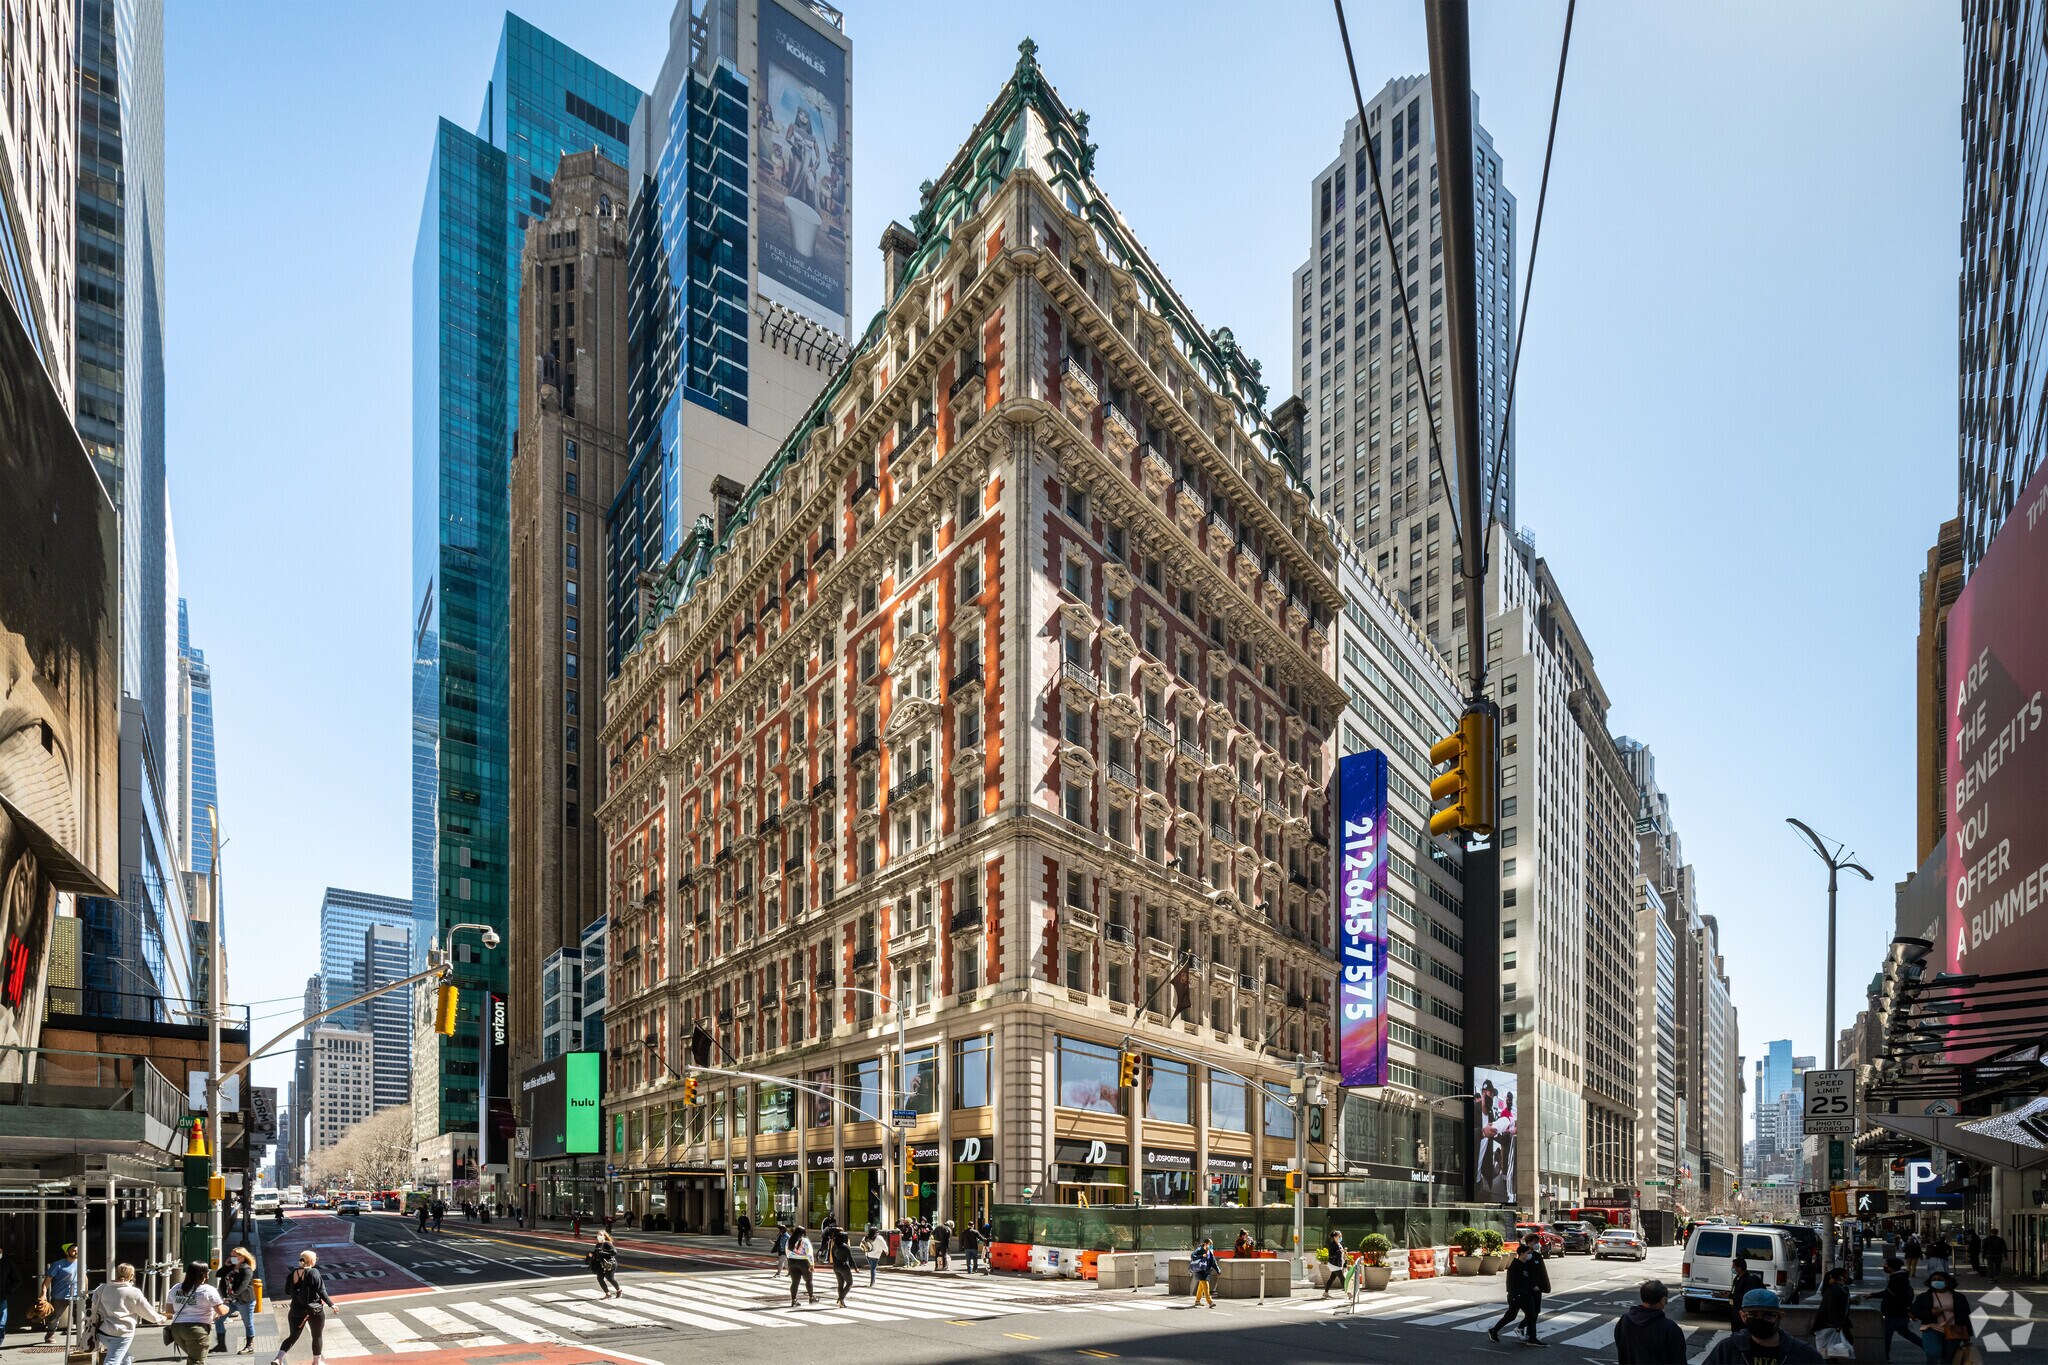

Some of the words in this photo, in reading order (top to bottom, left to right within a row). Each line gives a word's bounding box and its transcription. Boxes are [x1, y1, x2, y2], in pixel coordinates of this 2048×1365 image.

[776, 35, 785, 44] OF
[770, 245, 788, 259] FEEL
[790, 256, 805, 268] LIKE
[814, 269, 838, 287] QUEEN
[771, 252, 782, 264] ON
[785, 260, 801, 274] THIS
[1956, 646, 1989, 718] ARE
[1956, 700, 1986, 762] THE
[1956, 690, 2043, 814] BENEFITS
[1956, 802, 1988, 859] YOU
[1956, 838, 2010, 908] OFFER
[1344, 817, 1373, 1021] 212-645-7575
[1956, 926, 1968, 961] A
[1972, 862, 2048, 950] BUMMER
[492, 1002, 505, 1046] verizon
[571, 1098, 594, 1106] hulu
[1811, 1096, 1848, 1114] 25
[960, 1138, 980, 1162] JD
[1085, 1140, 1107, 1164] JD
[1156, 1154, 1190, 1164] JDSPORTS.COM
[1411, 1171, 1421, 1181] Foot
[1422, 1172, 1435, 1182] Locer
[1910, 1162, 1937, 1194] P
